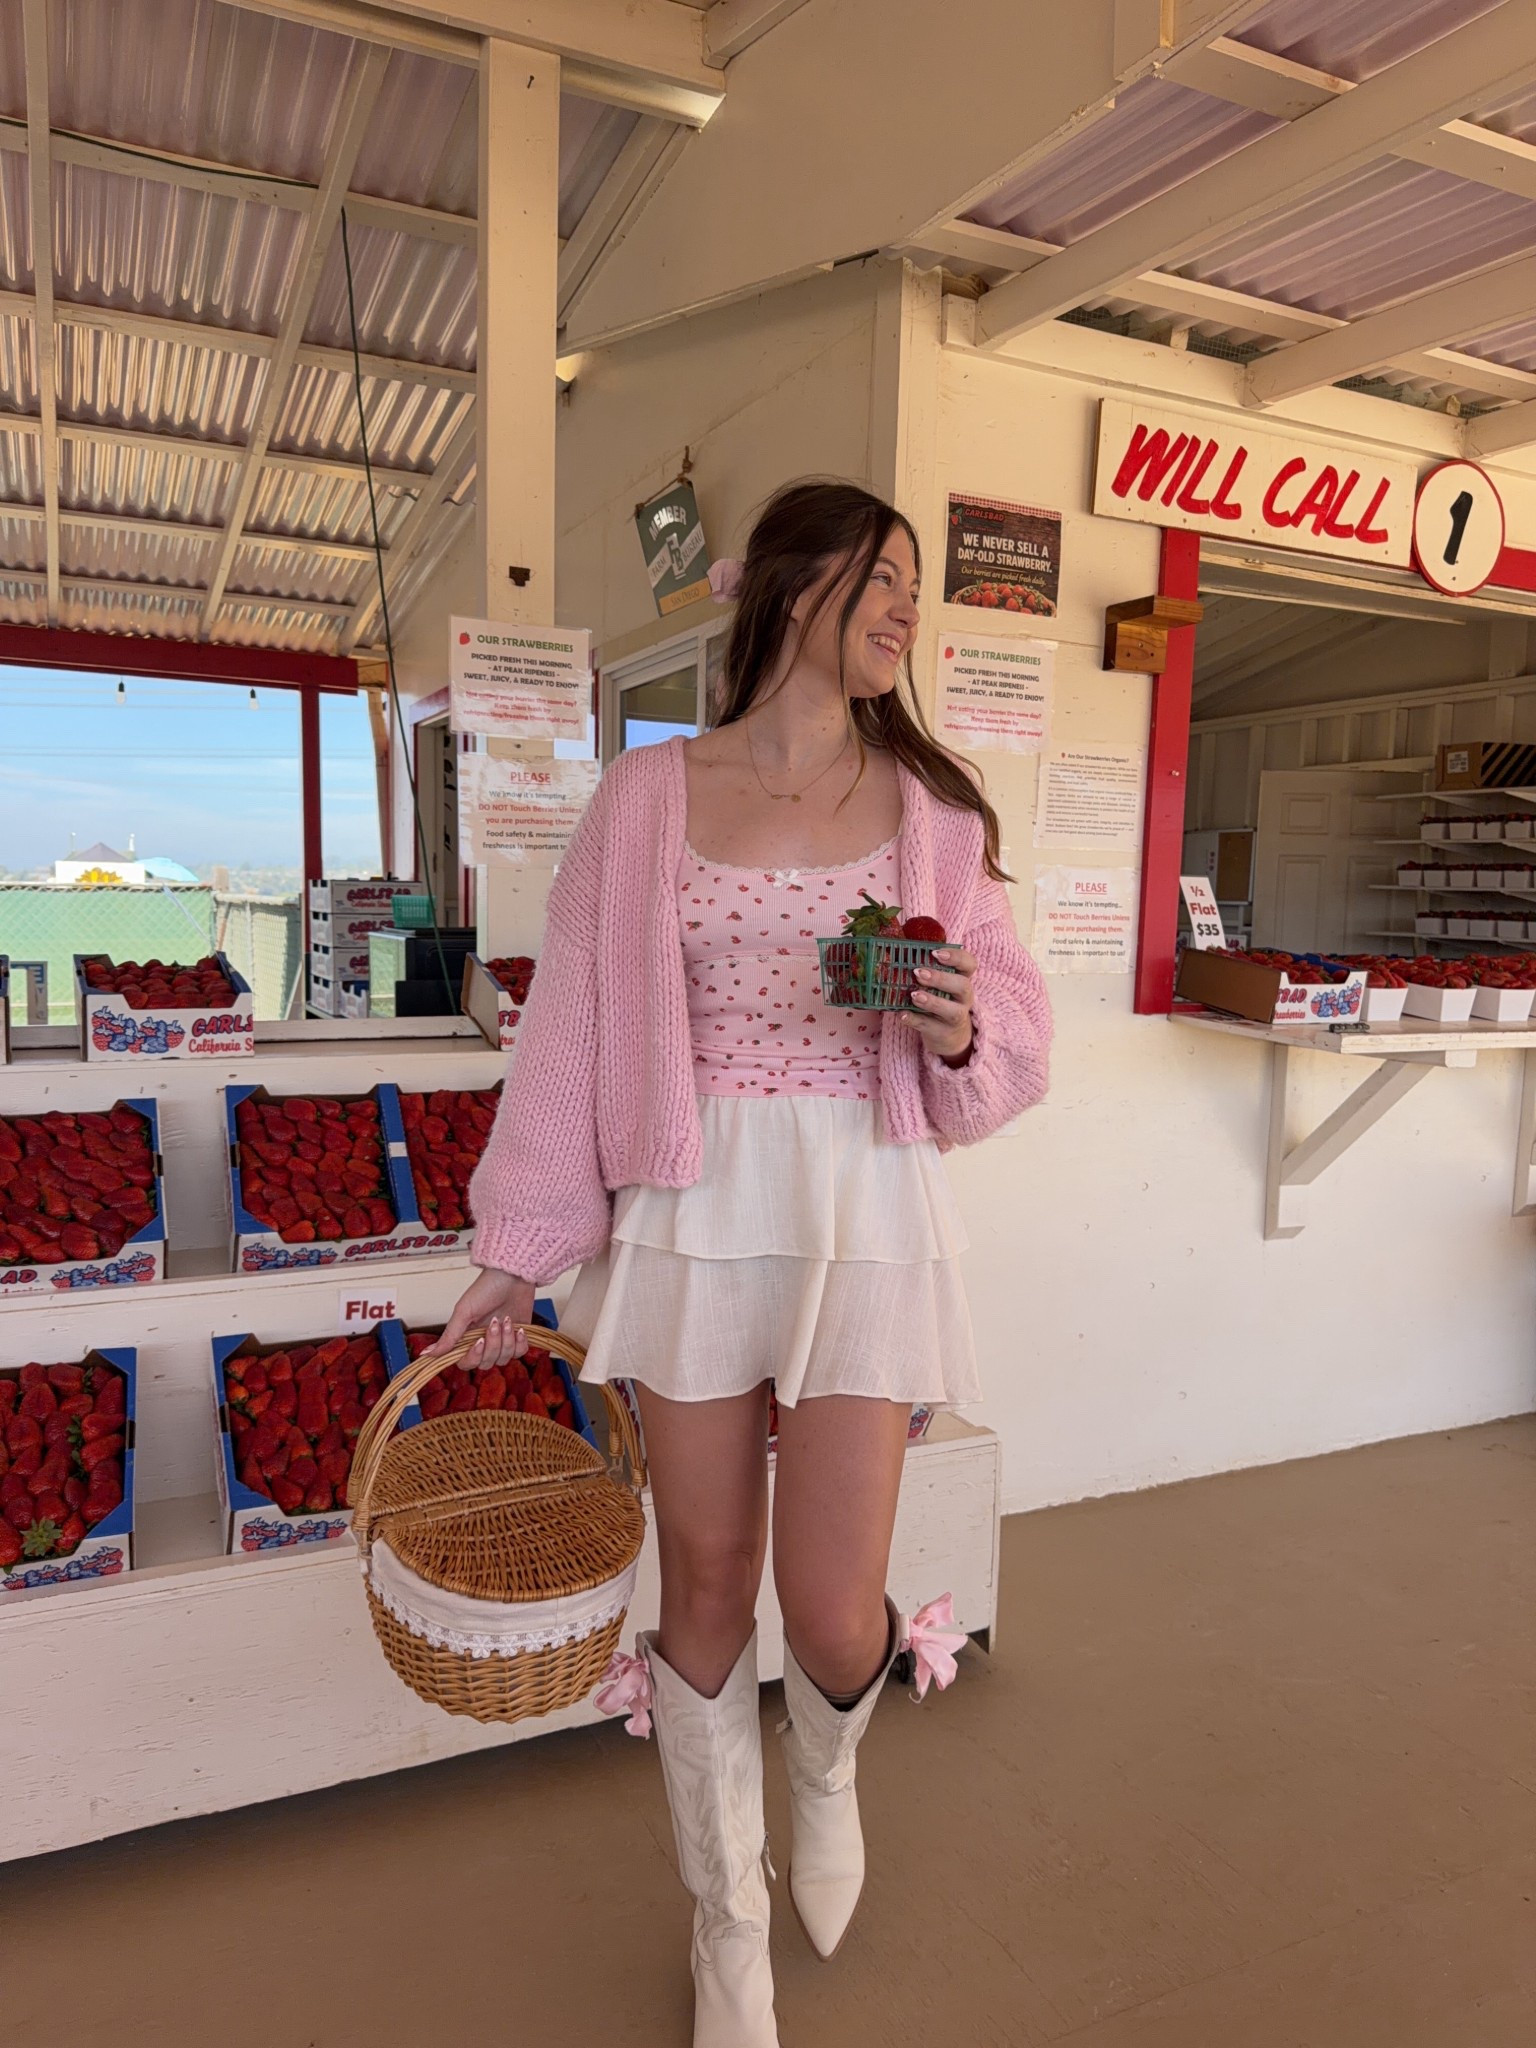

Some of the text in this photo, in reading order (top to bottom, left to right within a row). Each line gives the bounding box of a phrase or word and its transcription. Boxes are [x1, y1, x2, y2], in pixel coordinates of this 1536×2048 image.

[1111, 424, 1391, 544] WILL CALL
[649, 506, 686, 540] MEMBER
[965, 509, 1005, 521] CARLSBAD
[1443, 490, 1473, 566] 1
[652, 528, 702, 578] FARM BUREAU
[963, 533, 1048, 558] WE NEVER SELL A
[958, 548, 1052, 573] DAY-OLD STRAWBERRY.
[962, 566, 972, 574] Our
[974, 568, 990, 578] berries
[1002, 572, 1018, 582] picked
[1019, 572, 1031, 583] fresh
[1033, 576, 1046, 587] daily.
[477, 635, 573, 652] OUR STRAWBERRIES
[471, 653, 497, 661] PICKED
[539, 660, 572, 669] MORNING
[960, 648, 1041, 666] OUR STRAWBERRIES
[464, 672, 488, 681] SWEET,
[490, 675, 511, 683] JUICY,
[520, 678, 544, 686] READY
[524, 668, 555, 677] RIPENESS
[954, 667, 976, 675] PICKED
[1012, 673, 1040, 682] MORNING
[947, 687, 968, 695] SWEET,
[995, 691, 1014, 699] READY
[999, 682, 1024, 690] RIPENESS
[510, 772, 550, 783] PLEASE
[515, 818, 553, 826] purchasing
[1075, 882, 1107, 893] PLEASE
[1190, 903, 1216, 915] Flat
[1197, 923, 1220, 937] $35
[189, 1038, 241, 1054] California
[345, 1234, 459, 1257] CARLSBAD
[346, 1300, 395, 1320] Flat
